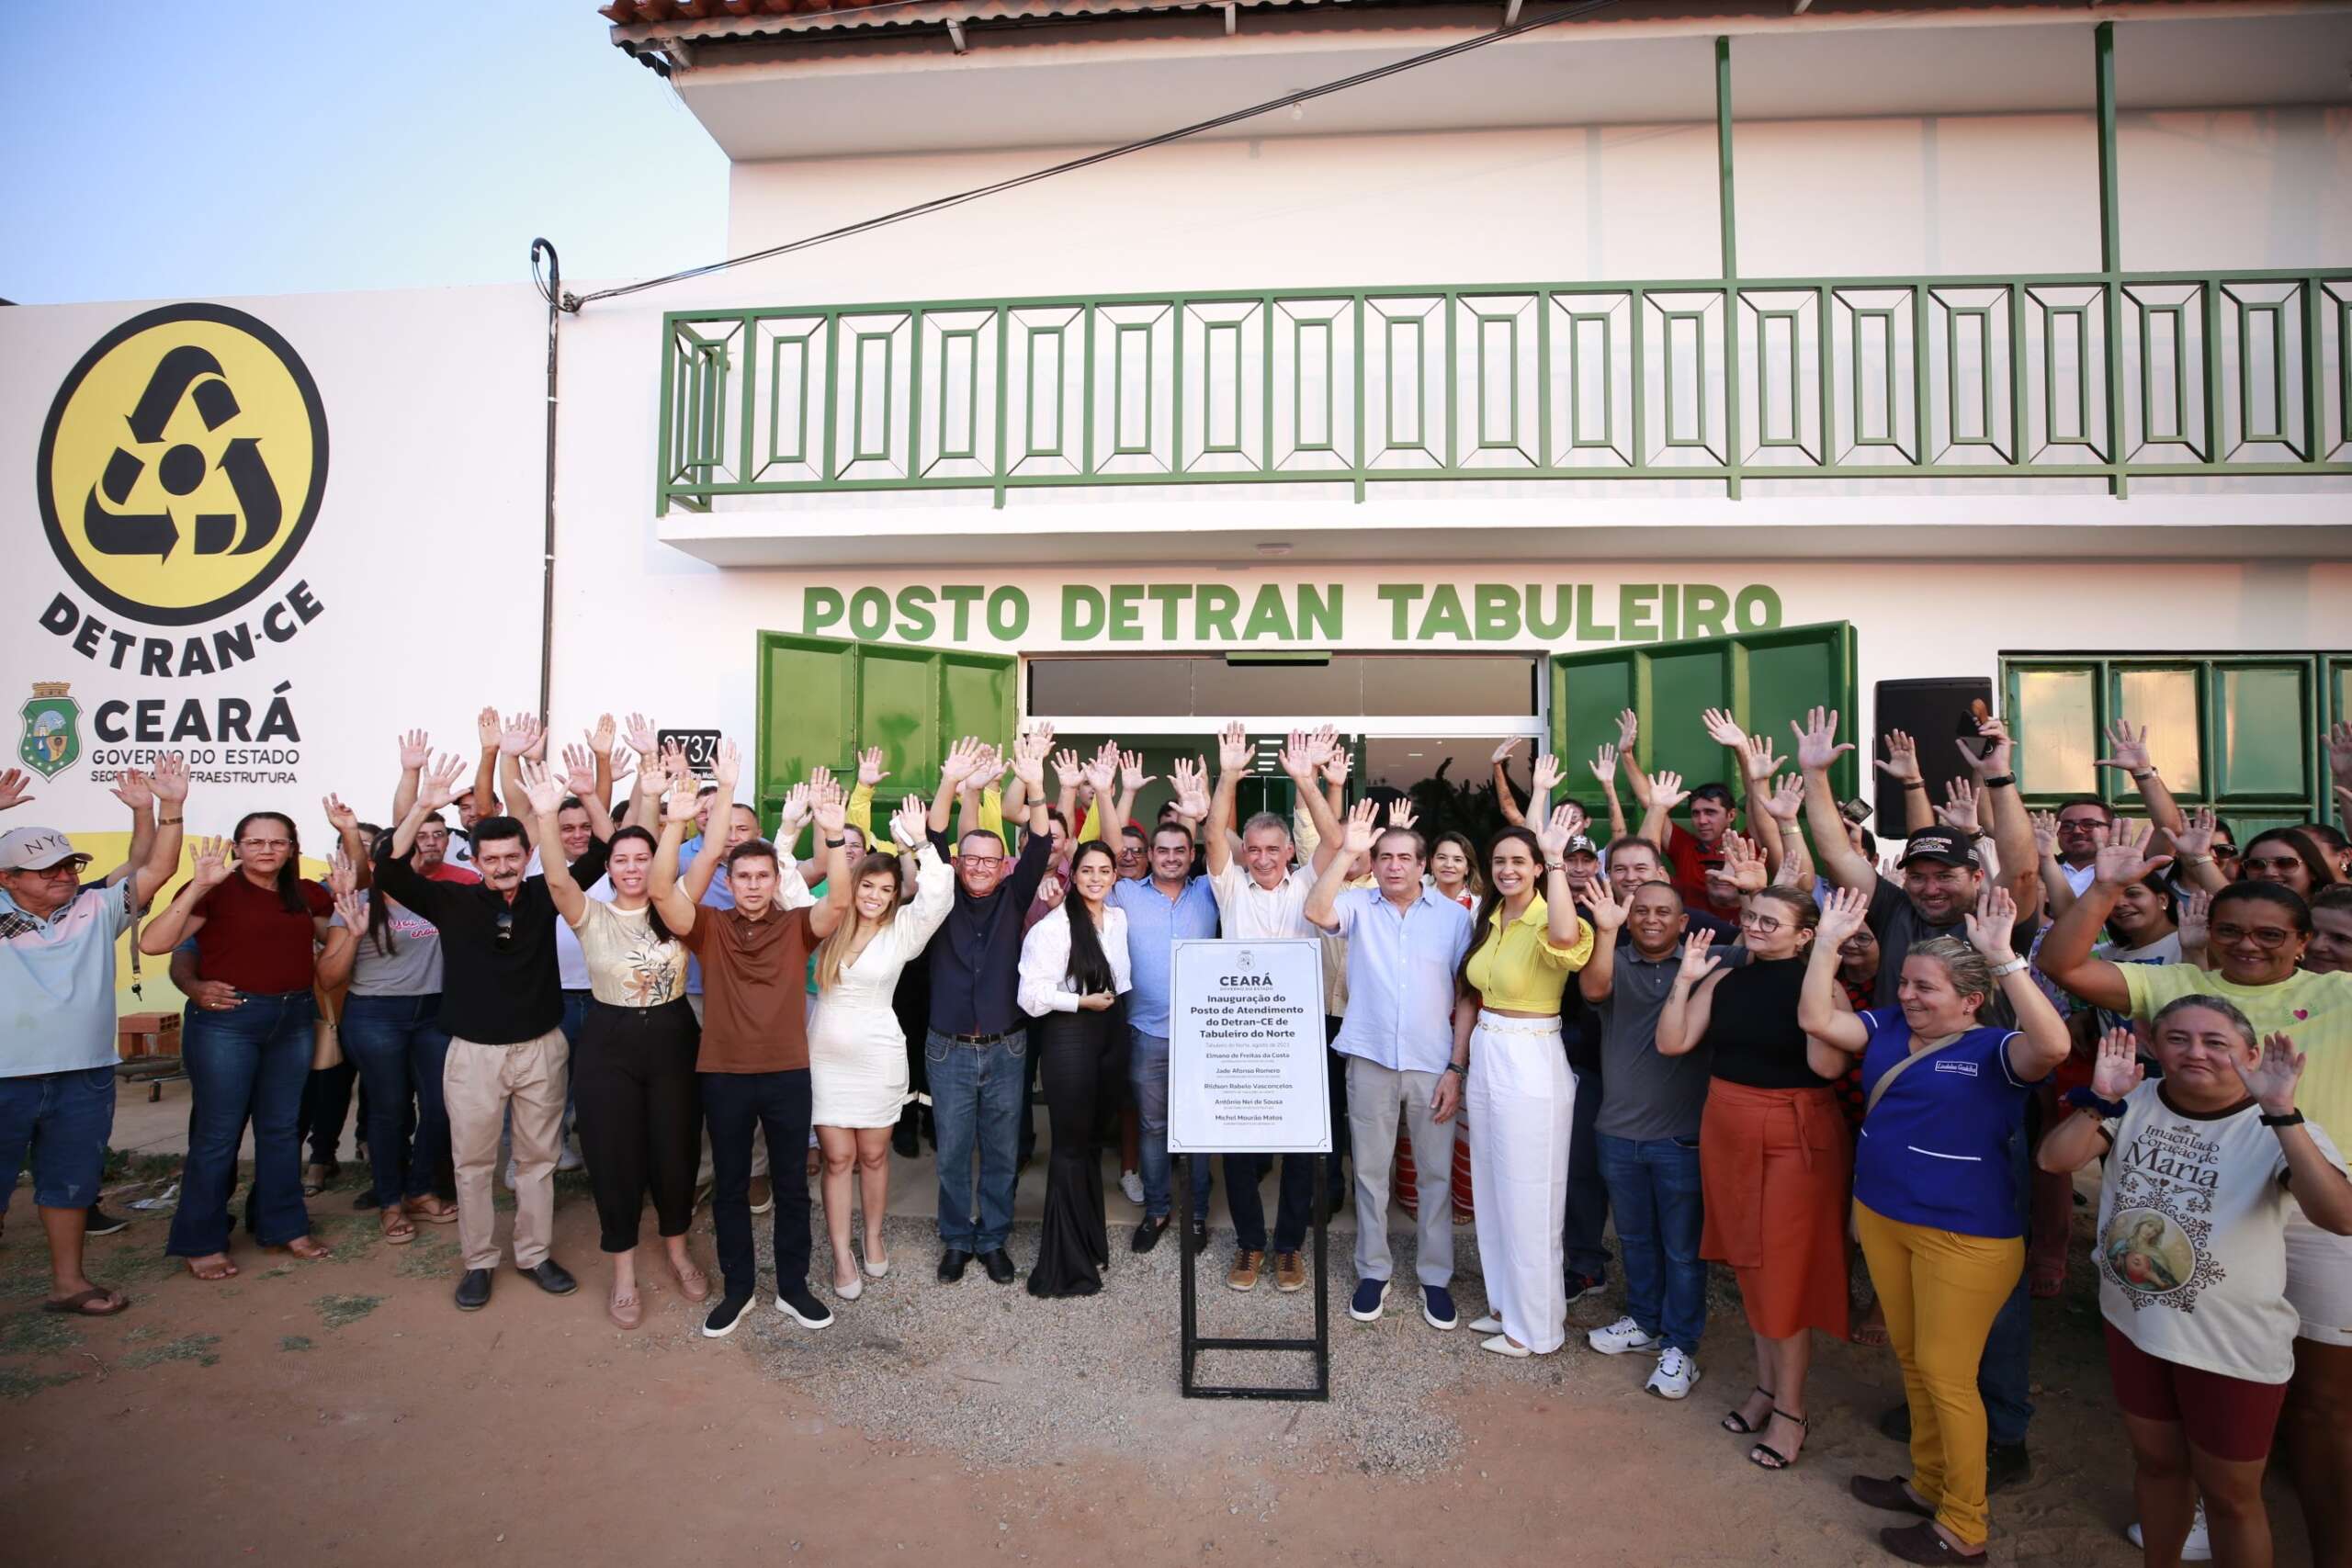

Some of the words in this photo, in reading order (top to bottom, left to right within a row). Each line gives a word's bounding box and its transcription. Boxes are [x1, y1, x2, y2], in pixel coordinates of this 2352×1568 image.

[802, 585, 1030, 641] POSTO
[1061, 584, 1343, 641] DETRAN
[1378, 584, 1782, 640] TABULEIRO
[39, 580, 325, 678] DETRAN-CE
[94, 680, 301, 742] CEARÁ
[190, 750, 215, 764] DO
[225, 750, 300, 764] ESTADO
[188, 772, 298, 783] FRAESTRUTURA
[24, 834, 71, 854] NYC
[411, 927, 439, 938] enou
[1219, 972, 1272, 986] CEARÁ
[1207, 995, 1271, 1004] Inauguração
[1237, 1006, 1304, 1014] Atendimento
[1221, 1018, 1273, 1026] Detran-CE
[1200, 1030, 1249, 1038] Tabuleiro
[1250, 1030, 1264, 1038] do
[1266, 1030, 1295, 1038] Norte
[2144, 1124, 2221, 1153] Imaculado
[2138, 1134, 2198, 1159] Coração
[2198, 1151, 2219, 1164] de
[2122, 1141, 2220, 1189] Maria
